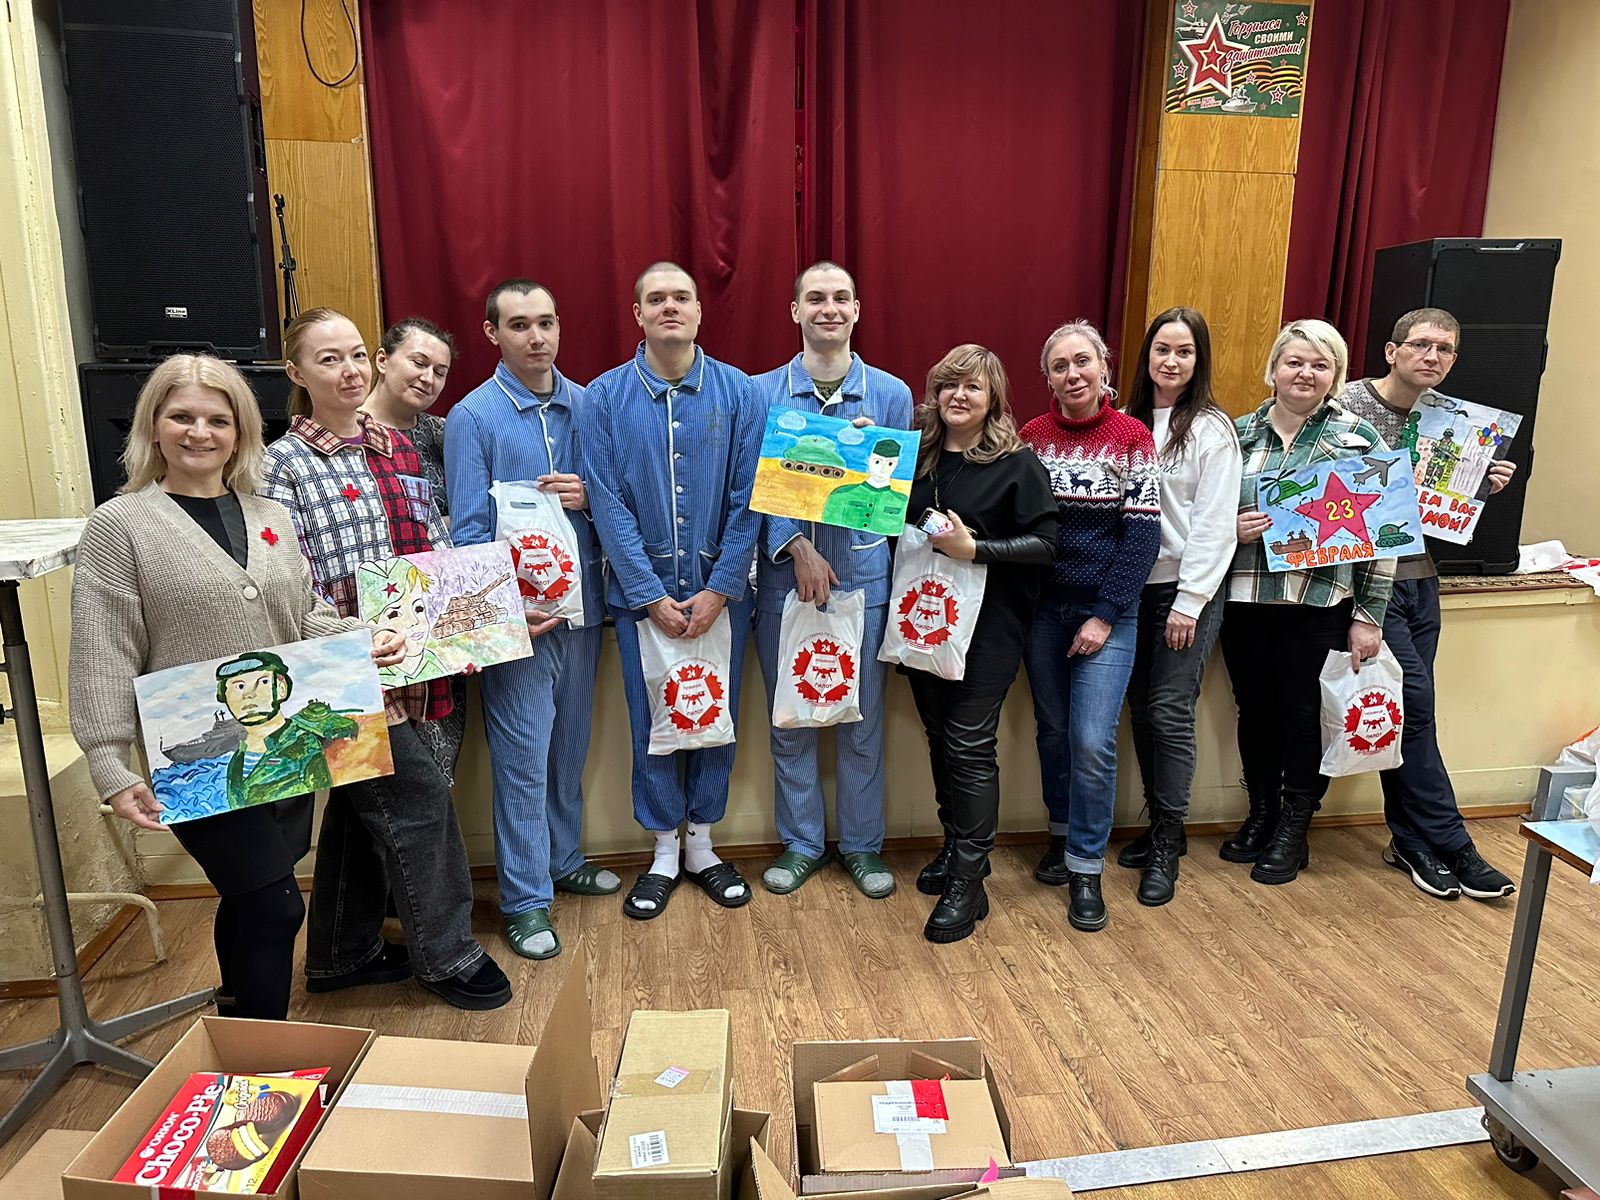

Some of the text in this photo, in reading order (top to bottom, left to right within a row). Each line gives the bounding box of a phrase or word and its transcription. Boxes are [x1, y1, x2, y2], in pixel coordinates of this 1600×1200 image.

[1228, 19, 1282, 39] Гордимся
[1254, 31, 1294, 44] СВОИМИ
[1418, 490, 1477, 516] ЕМ ВАС
[1325, 498, 1355, 521] 23
[529, 538, 540, 547] 24
[1286, 541, 1374, 568] ФЕВРАЛЯ
[928, 585, 937, 594] 24
[915, 623, 934, 631] ПИЛОТ
[821, 644, 831, 652] 24
[687, 669, 696, 678] 24
[1368, 696, 1378, 705] 24
[149, 1111, 180, 1147] ORION
